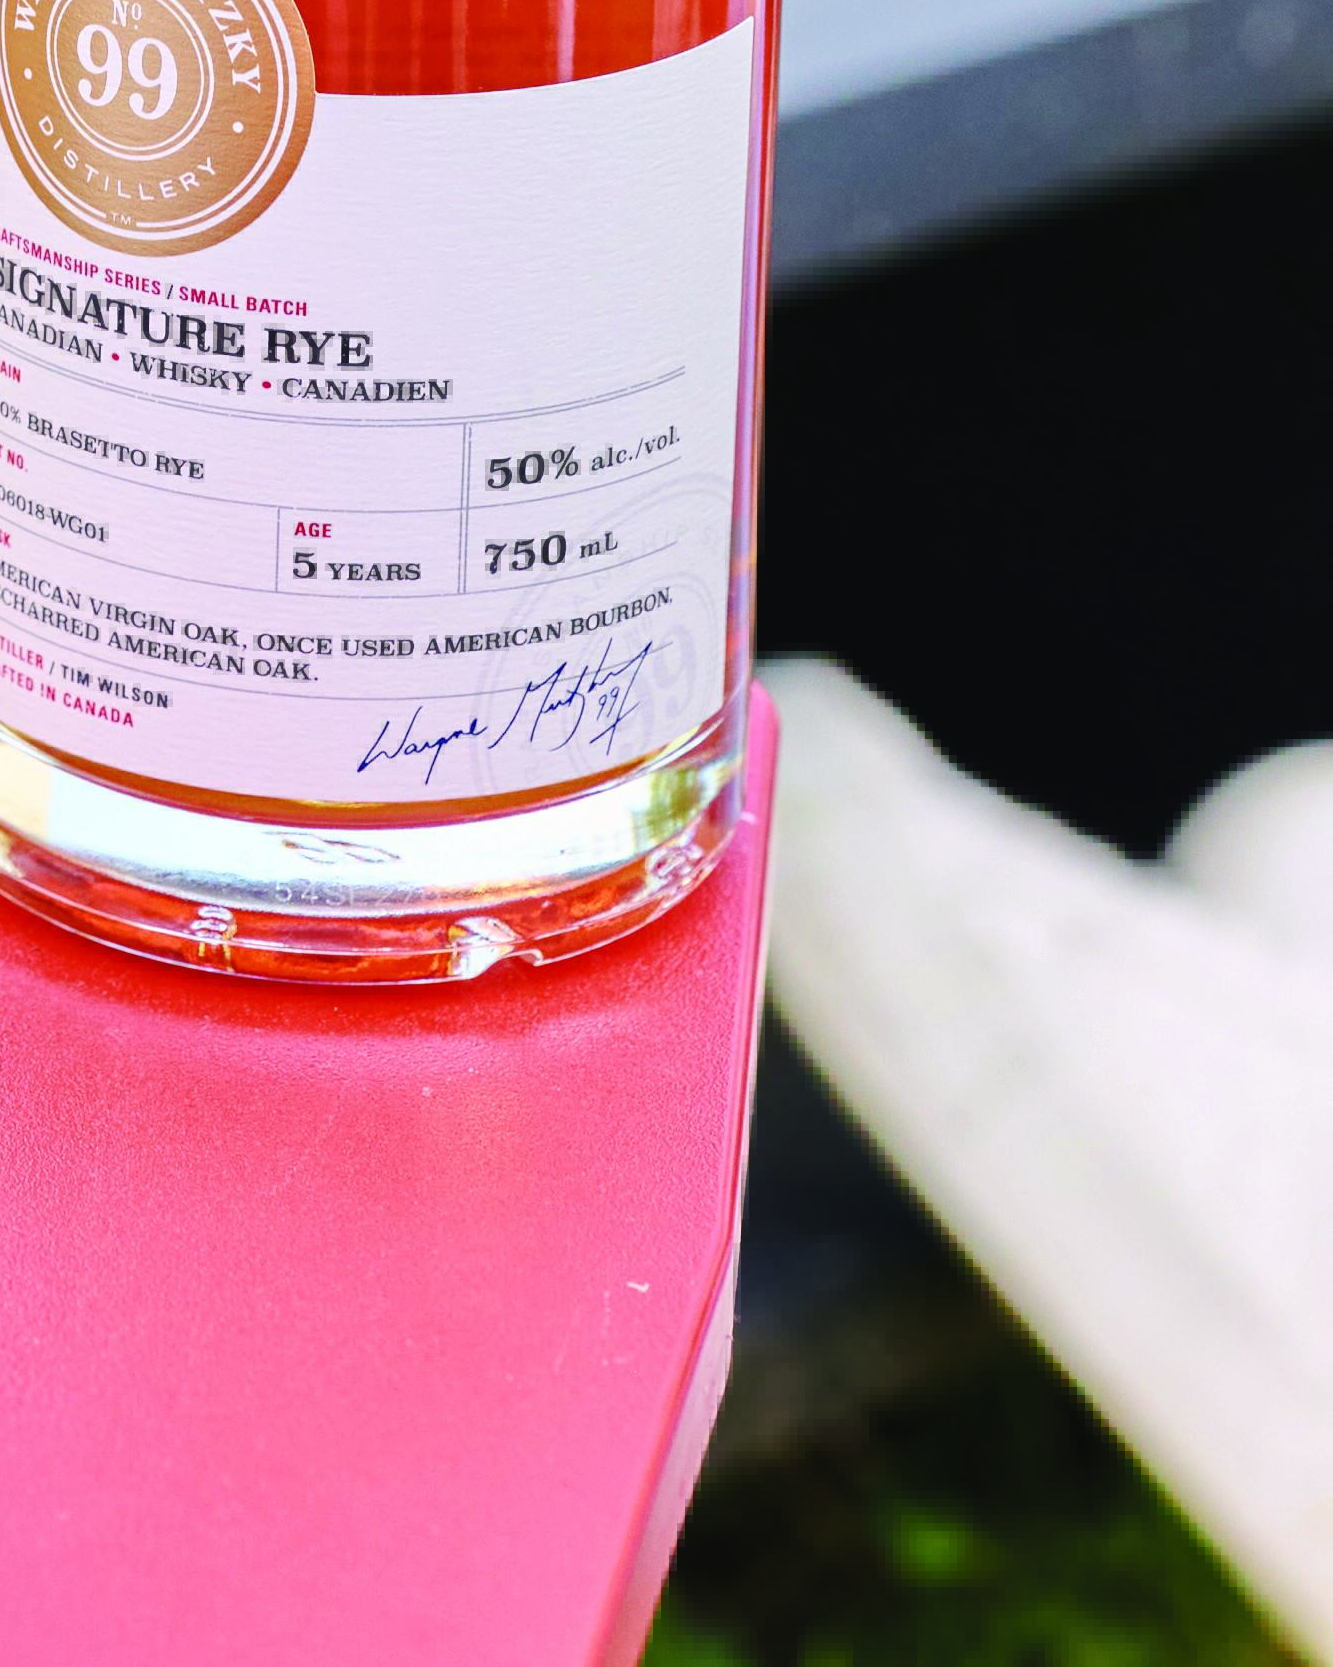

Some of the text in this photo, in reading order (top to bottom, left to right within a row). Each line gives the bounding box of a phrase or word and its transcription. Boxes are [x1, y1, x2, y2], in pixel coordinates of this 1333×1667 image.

[75, 23, 179, 121] 99
[38, 115, 216, 201] DISTILLERY
[104, 268, 161, 296] SERIES
[179, 286, 240, 310] SMALL
[246, 296, 308, 317] BATCH
[263, 327, 371, 368] RYE
[130, 351, 252, 393] WHISKY
[282, 378, 450, 403] CANADIEN
[6, 448, 28, 473] NO.
[27, 412, 147, 468] BRASETTO
[154, 453, 205, 480] RYE
[486, 424, 682, 490] 50% alc./vol.
[293, 520, 332, 539] AGE
[484, 530, 619, 575] 750 mL
[292, 552, 422, 582] 5 YEARS
[89, 596, 176, 637] VIRGIN
[184, 621, 248, 651] OAK,
[256, 632, 333, 657] ONCE
[341, 637, 415, 657] USED
[424, 621, 563, 657] AMERICAN
[107, 631, 245, 676] AMERICAN
[252, 658, 319, 682] OAK.
[40, 683, 56, 703] IN
[62, 692, 134, 728] CANADA
[61, 664, 91, 688] TIM
[98, 676, 169, 709] WILSON
